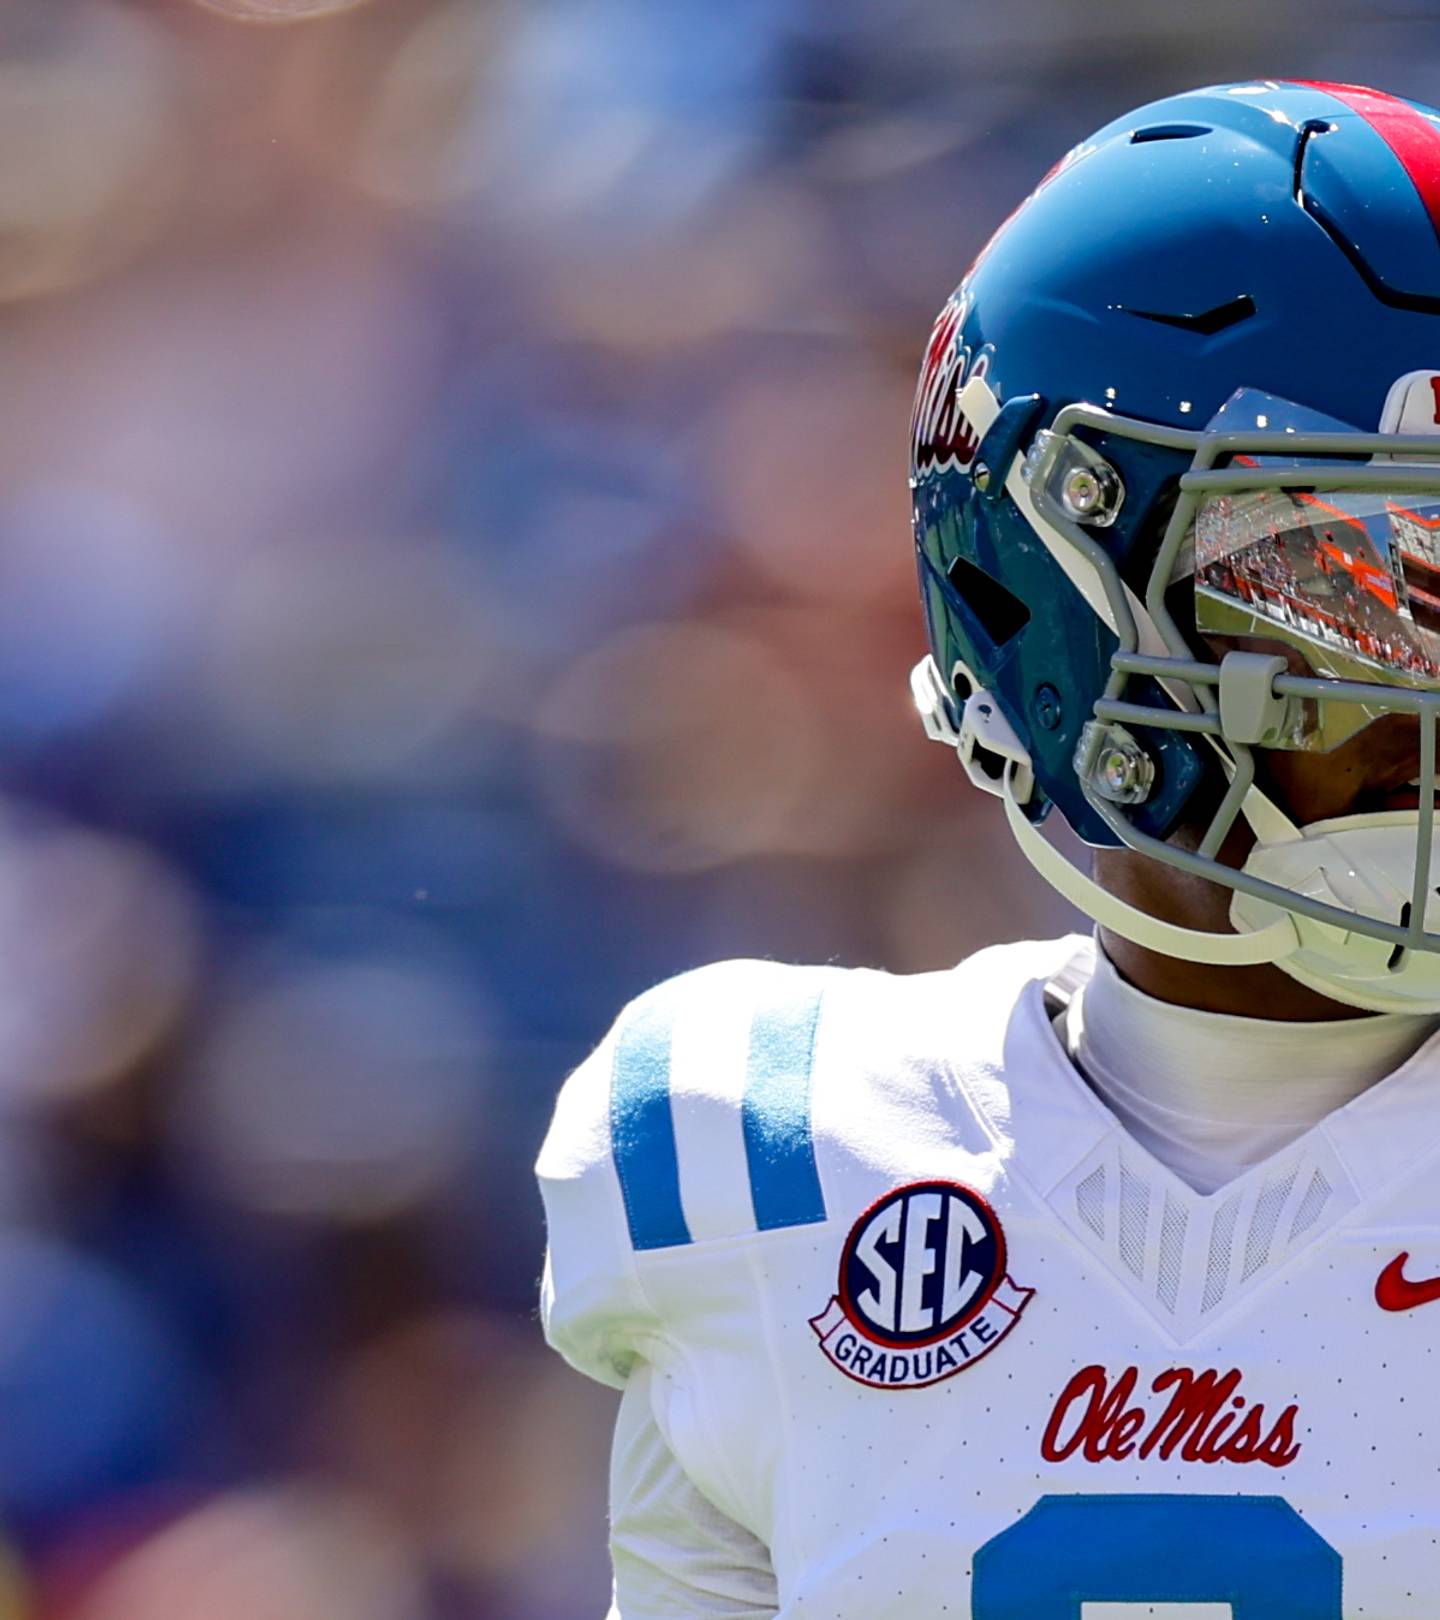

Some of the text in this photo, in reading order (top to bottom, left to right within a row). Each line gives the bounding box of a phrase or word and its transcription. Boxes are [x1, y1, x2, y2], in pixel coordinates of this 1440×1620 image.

[855, 1193, 988, 1333] SEC
[834, 1315, 999, 1383] GRADUATE
[1041, 1365, 1301, 1468] Ole Miss
